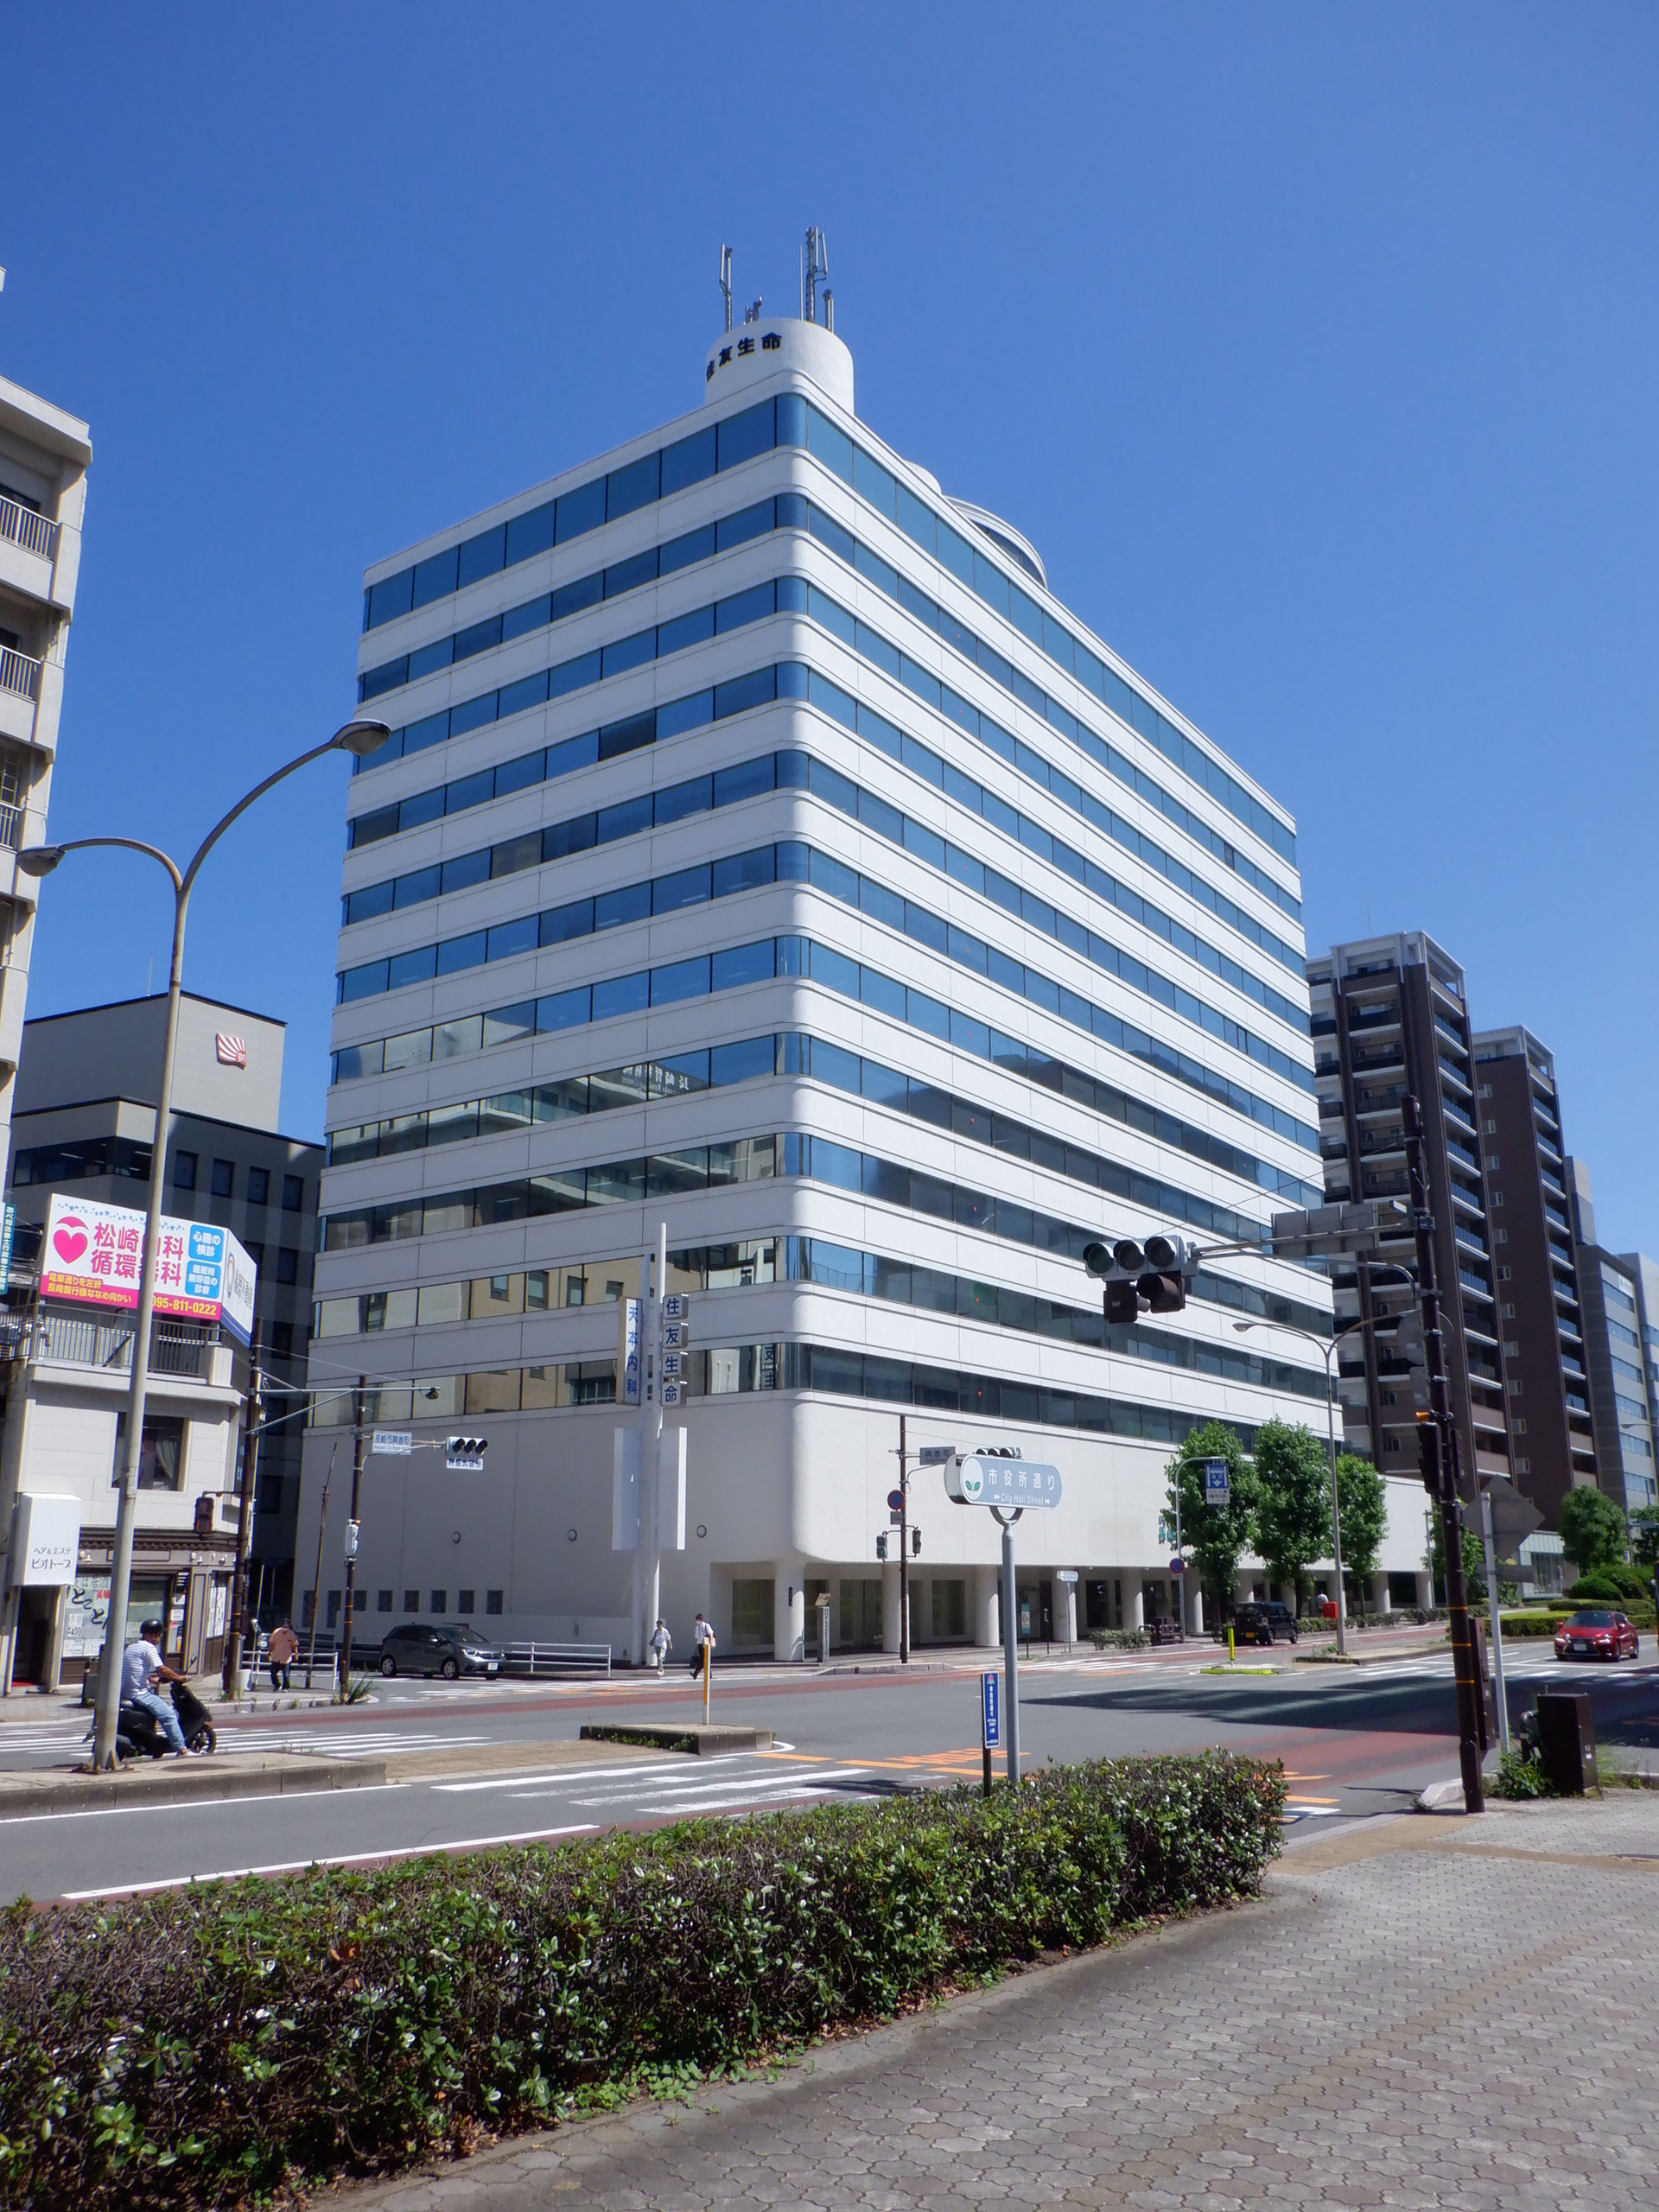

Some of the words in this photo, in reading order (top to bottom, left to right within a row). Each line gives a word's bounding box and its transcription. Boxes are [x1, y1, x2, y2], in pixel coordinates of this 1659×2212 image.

[48, 1272, 103, 1290] 電車通りを左折
[91, 1249, 181, 1287] 循環科
[626, 1306, 639, 1396] 天本内科
[664, 1298, 680, 1403] 住友生命
[988, 1468, 1055, 1491] 市役所通り
[1001, 1492, 1013, 1504] City
[1014, 1494, 1027, 1504] Hall
[1027, 1494, 1044, 1505] Street
